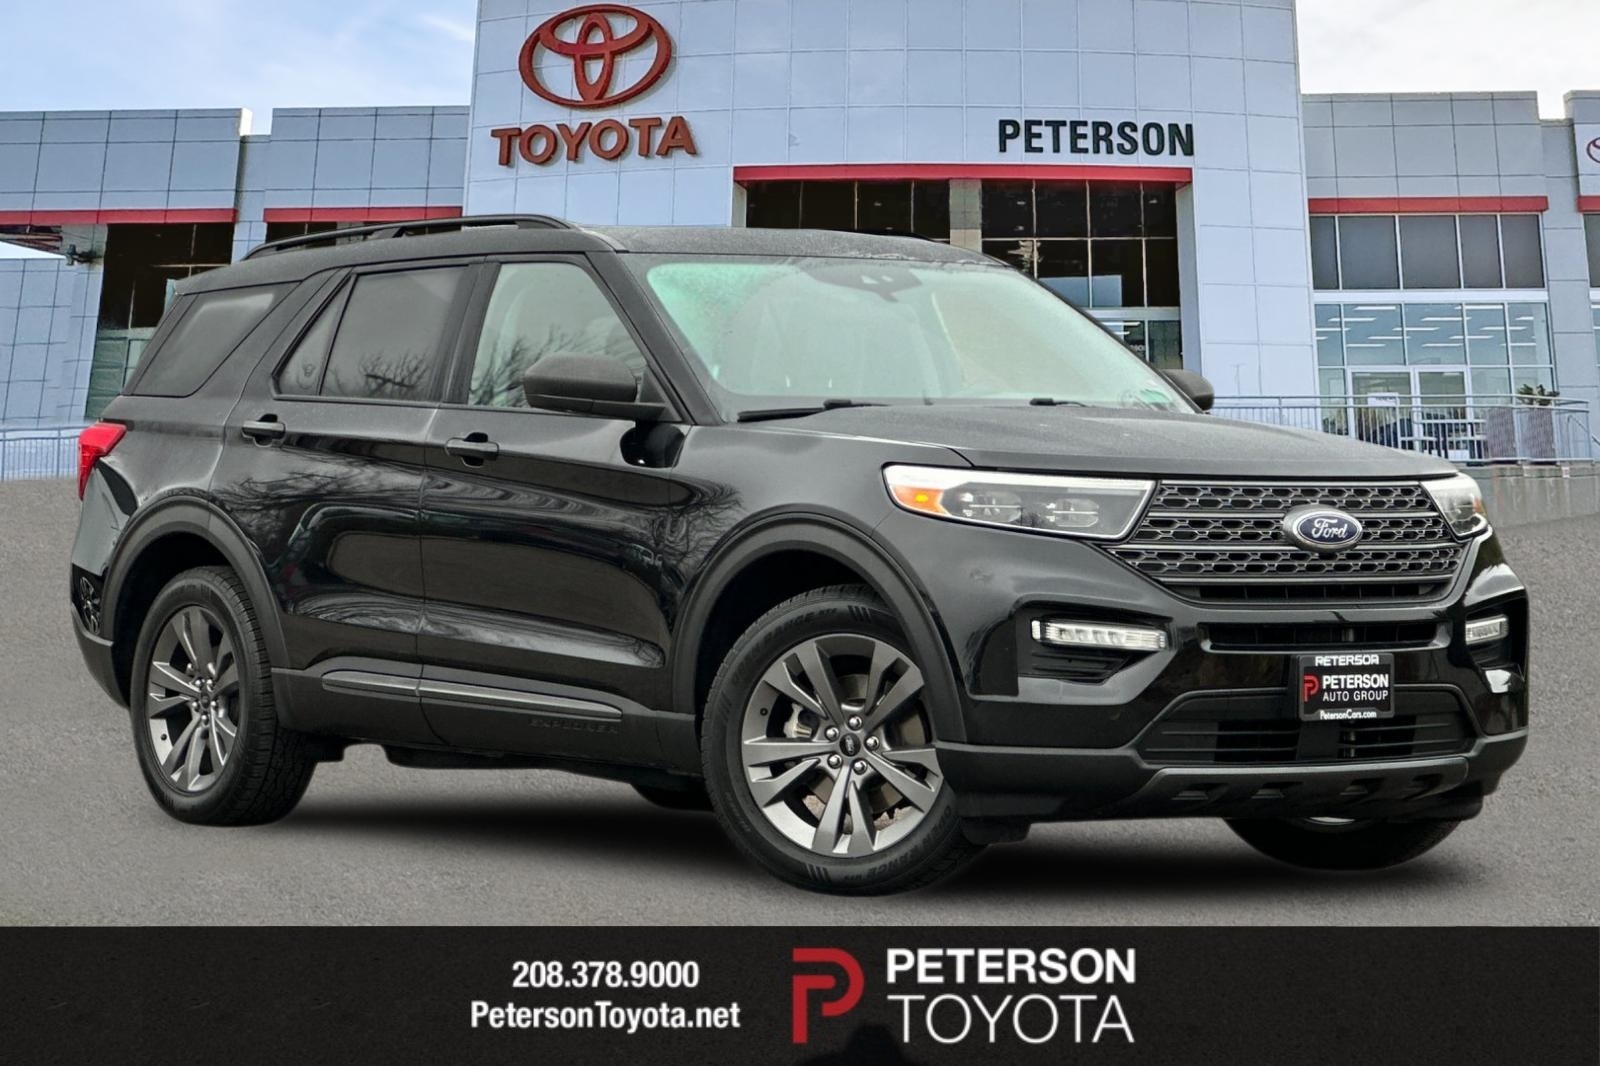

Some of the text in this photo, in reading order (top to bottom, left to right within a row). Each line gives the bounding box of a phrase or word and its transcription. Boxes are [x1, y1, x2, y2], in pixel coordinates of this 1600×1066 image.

[491, 116, 697, 166] TOYOTA
[998, 119, 1195, 157] PETERSON
[1311, 517, 1348, 539] Ford
[1322, 674, 1389, 689] PETERSON
[1322, 690, 1388, 702] AUTO GROUP
[1320, 708, 1377, 720] PetersonCars.com
